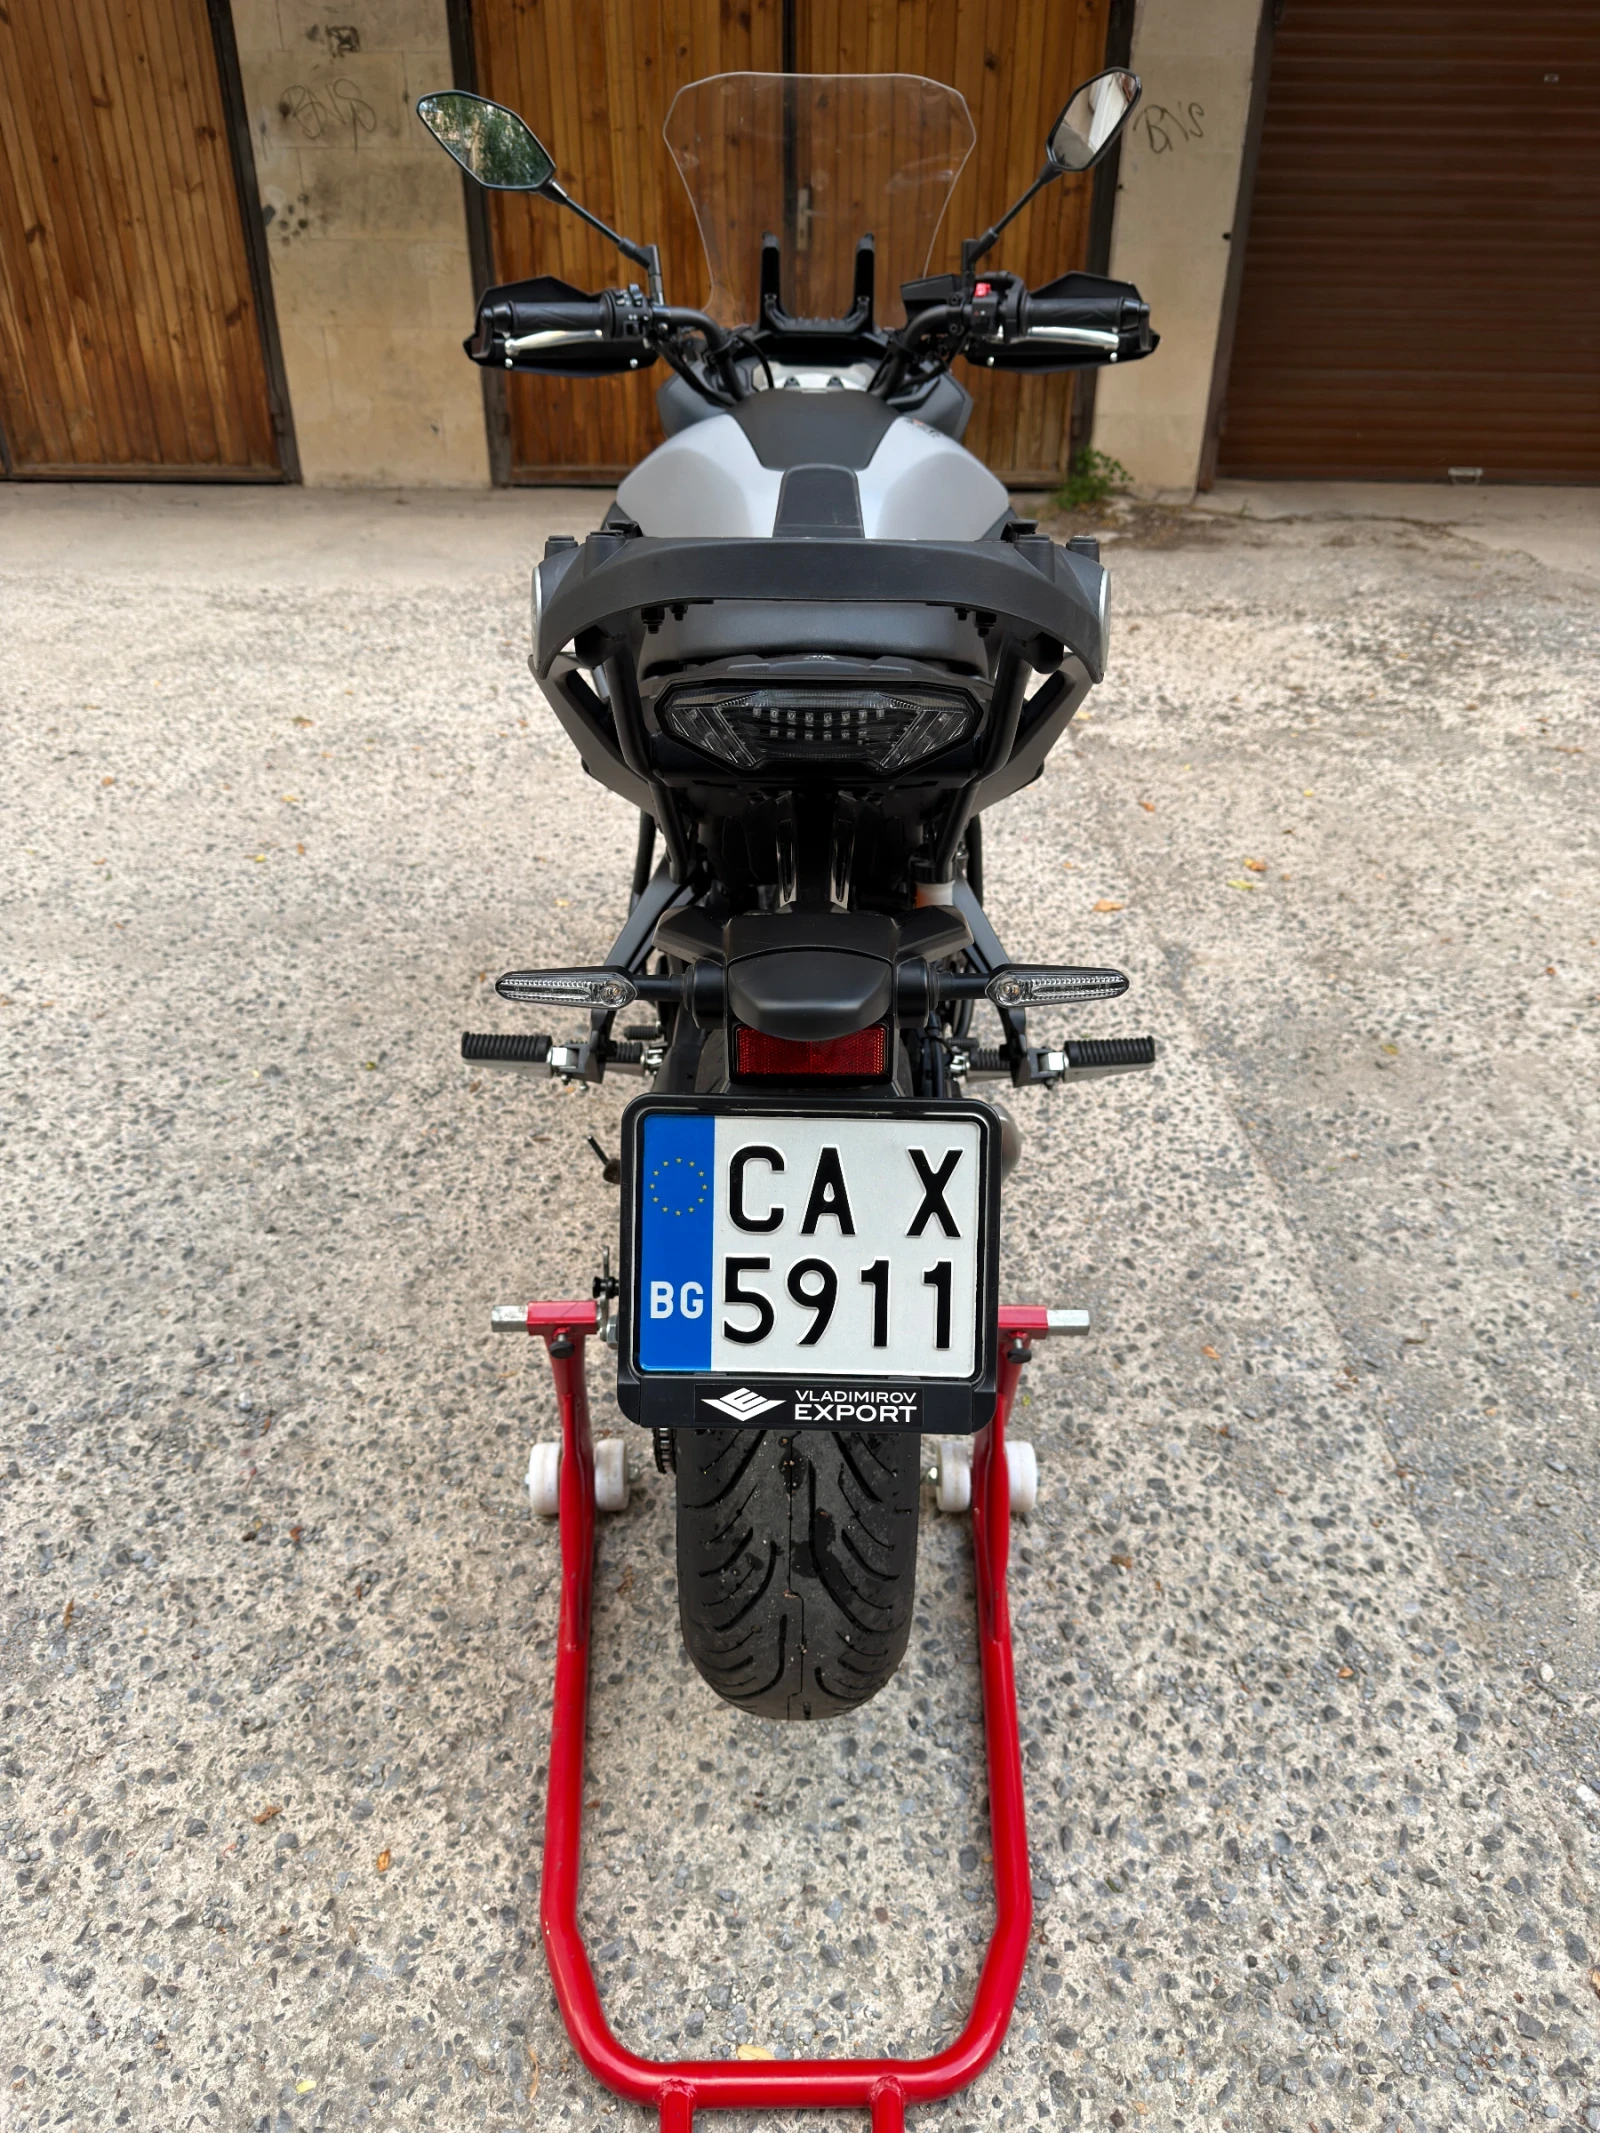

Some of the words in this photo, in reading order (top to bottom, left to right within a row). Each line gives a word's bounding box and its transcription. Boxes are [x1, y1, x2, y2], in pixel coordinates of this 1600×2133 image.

[729, 1144, 856, 1236] CA
[905, 1148, 965, 1238] X
[649, 1281, 705, 1320] BG
[722, 1255, 955, 1350] 5911
[794, 1403, 918, 1423] EXPORT
[795, 1389, 918, 1404] VLADIMIROV
